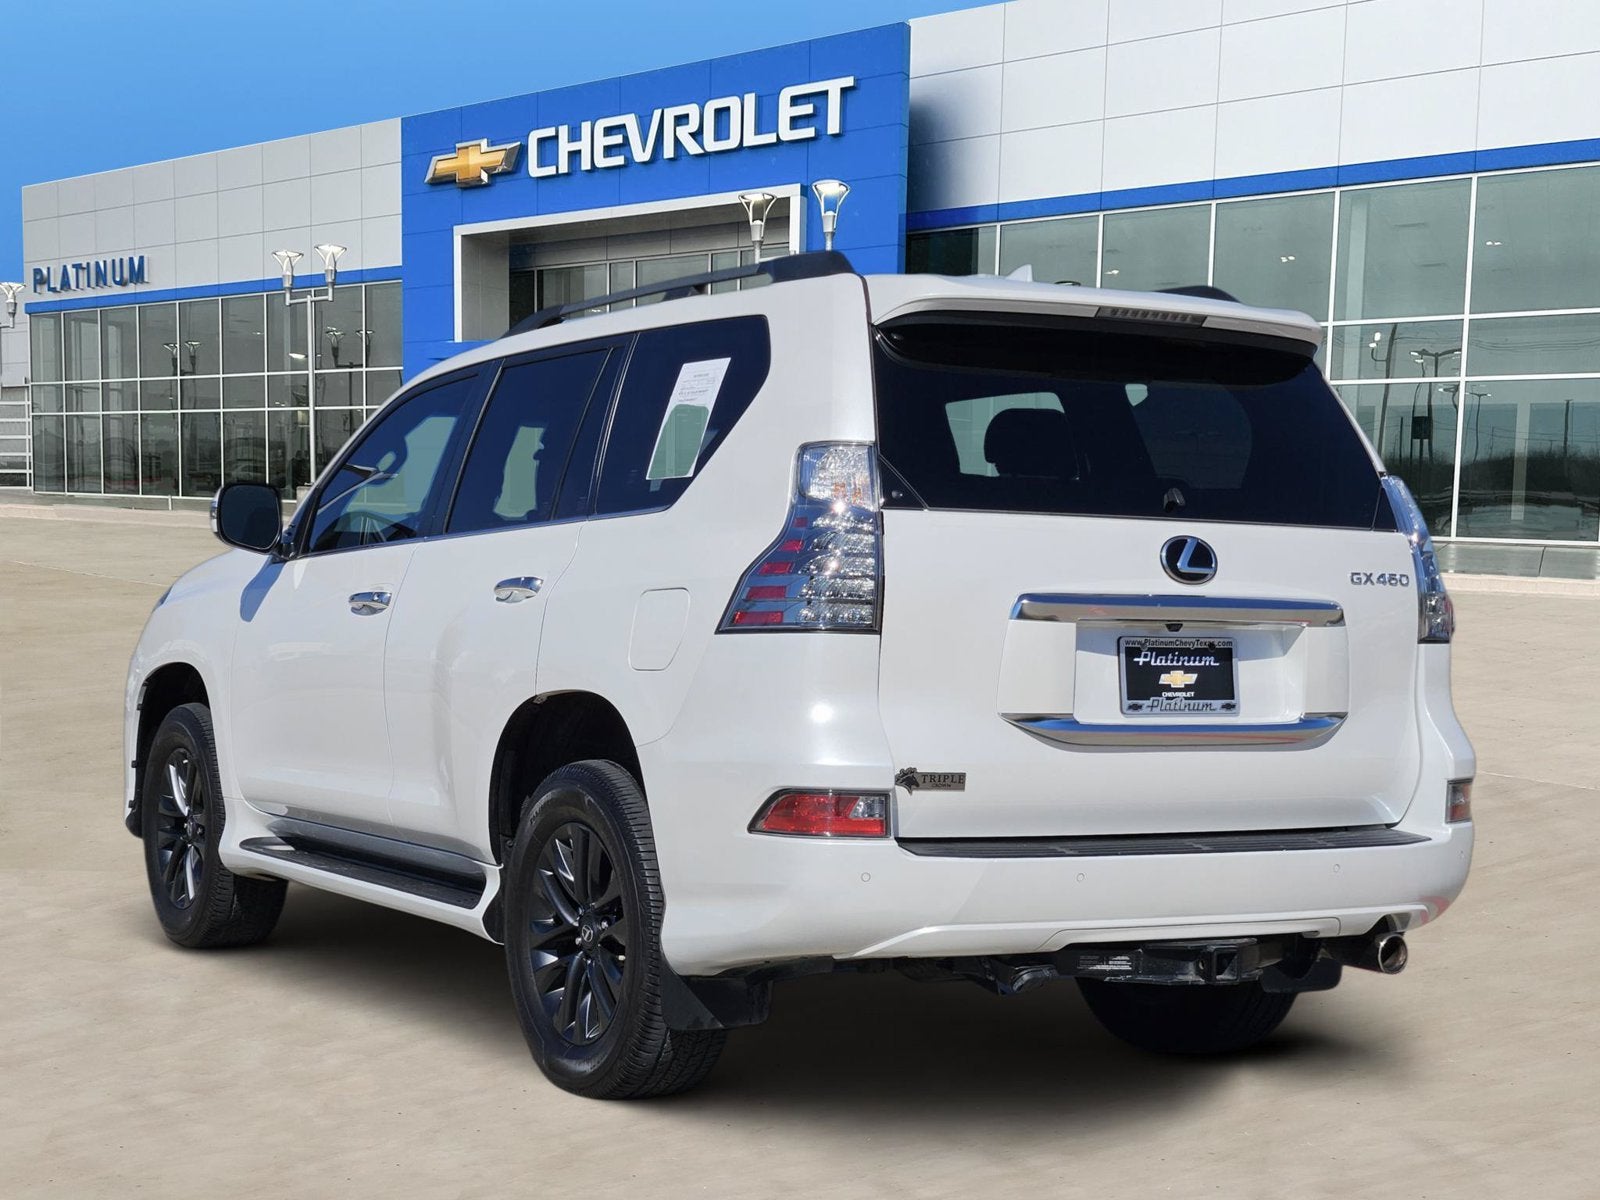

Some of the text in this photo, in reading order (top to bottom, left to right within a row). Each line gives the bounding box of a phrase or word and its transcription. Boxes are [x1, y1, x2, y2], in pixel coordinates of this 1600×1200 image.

[527, 75, 856, 178] CHEVROLET
[33, 255, 145, 293] PLATINUM
[1350, 571, 1410, 587] GX460
[1124, 638, 1233, 649] wwwPlatinumChevyTexa.com
[1133, 651, 1220, 666] Platinum
[1146, 697, 1217, 712] Platinum
[921, 774, 966, 784] TRIPLE
